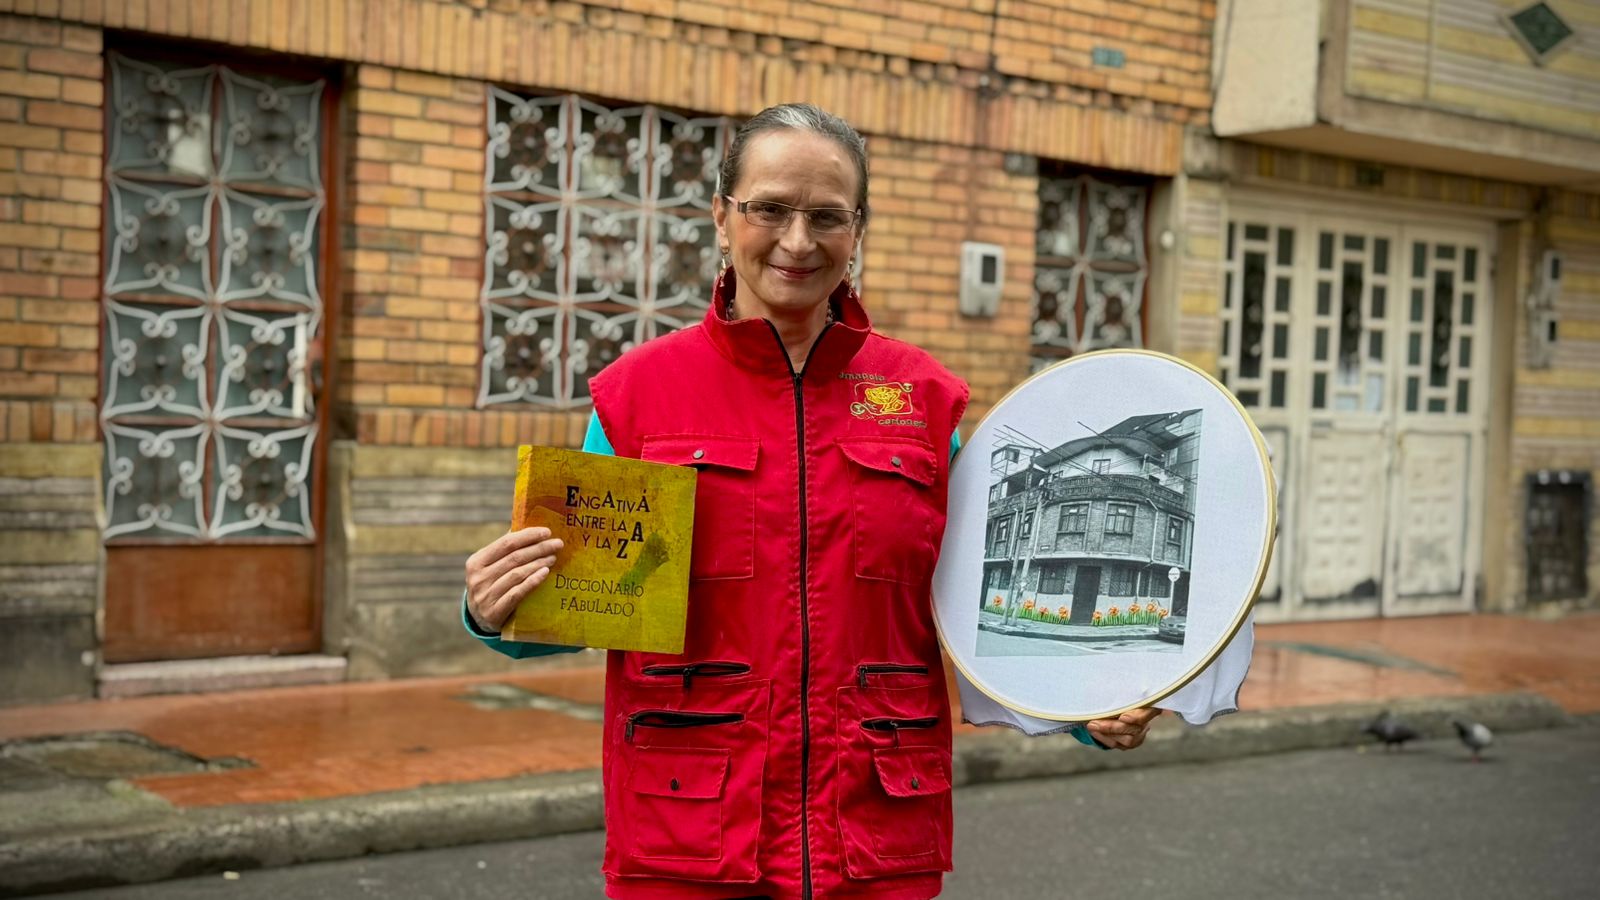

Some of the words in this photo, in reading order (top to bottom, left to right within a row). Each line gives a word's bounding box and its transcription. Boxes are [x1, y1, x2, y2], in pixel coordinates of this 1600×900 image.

[565, 485, 650, 513] ENGATIVÁ
[566, 513, 606, 530] ENTRE
[611, 518, 627, 532] LA
[630, 521, 644, 542] A
[582, 534, 591, 547] Y
[596, 536, 612, 550] LA
[616, 538, 629, 559] Z
[555, 573, 644, 597] DICCIONARIO
[560, 596, 635, 617] FABULADO
